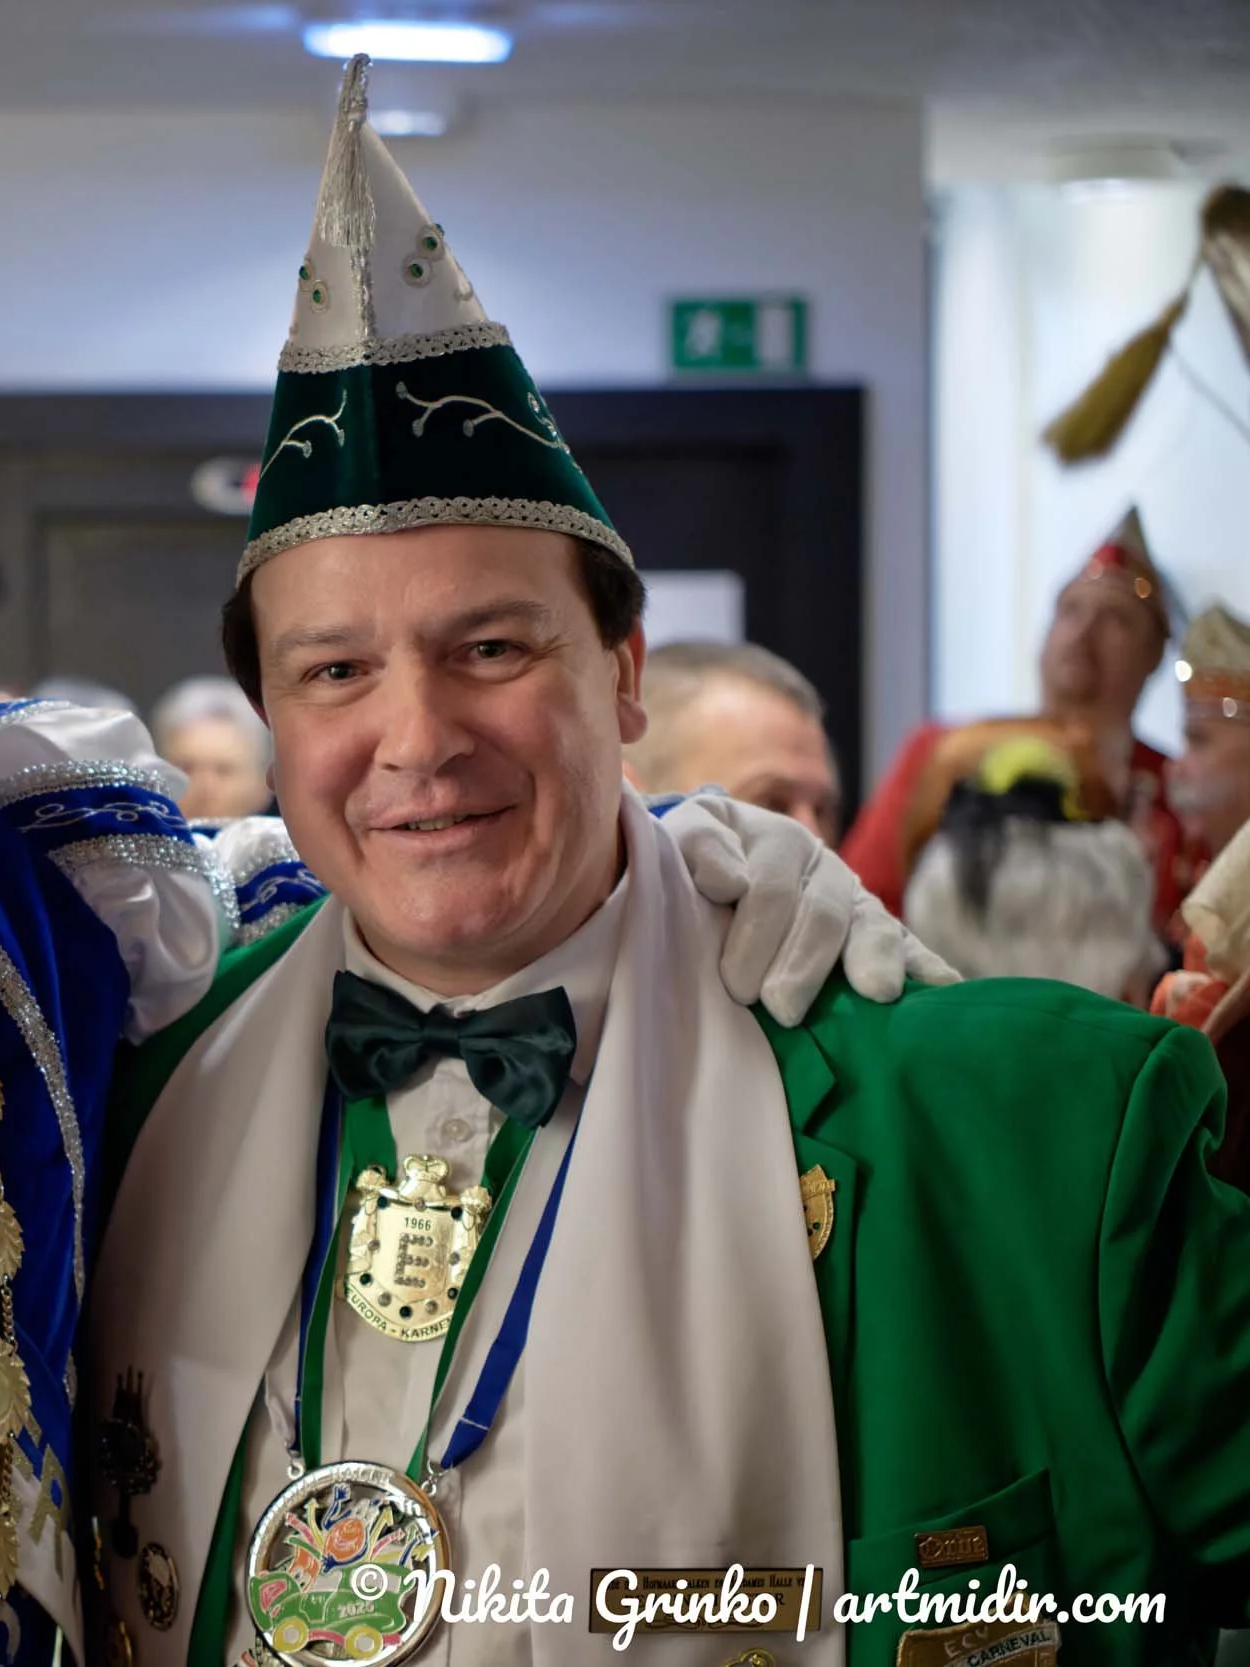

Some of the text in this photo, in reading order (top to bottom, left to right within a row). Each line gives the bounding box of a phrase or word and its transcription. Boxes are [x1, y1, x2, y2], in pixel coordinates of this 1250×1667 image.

[404, 1216, 431, 1231] 1966
[394, 1231, 434, 1289] E
[401, 1318, 451, 1338] KARNE
[966, 1629, 1052, 1667] CARNEVAL
